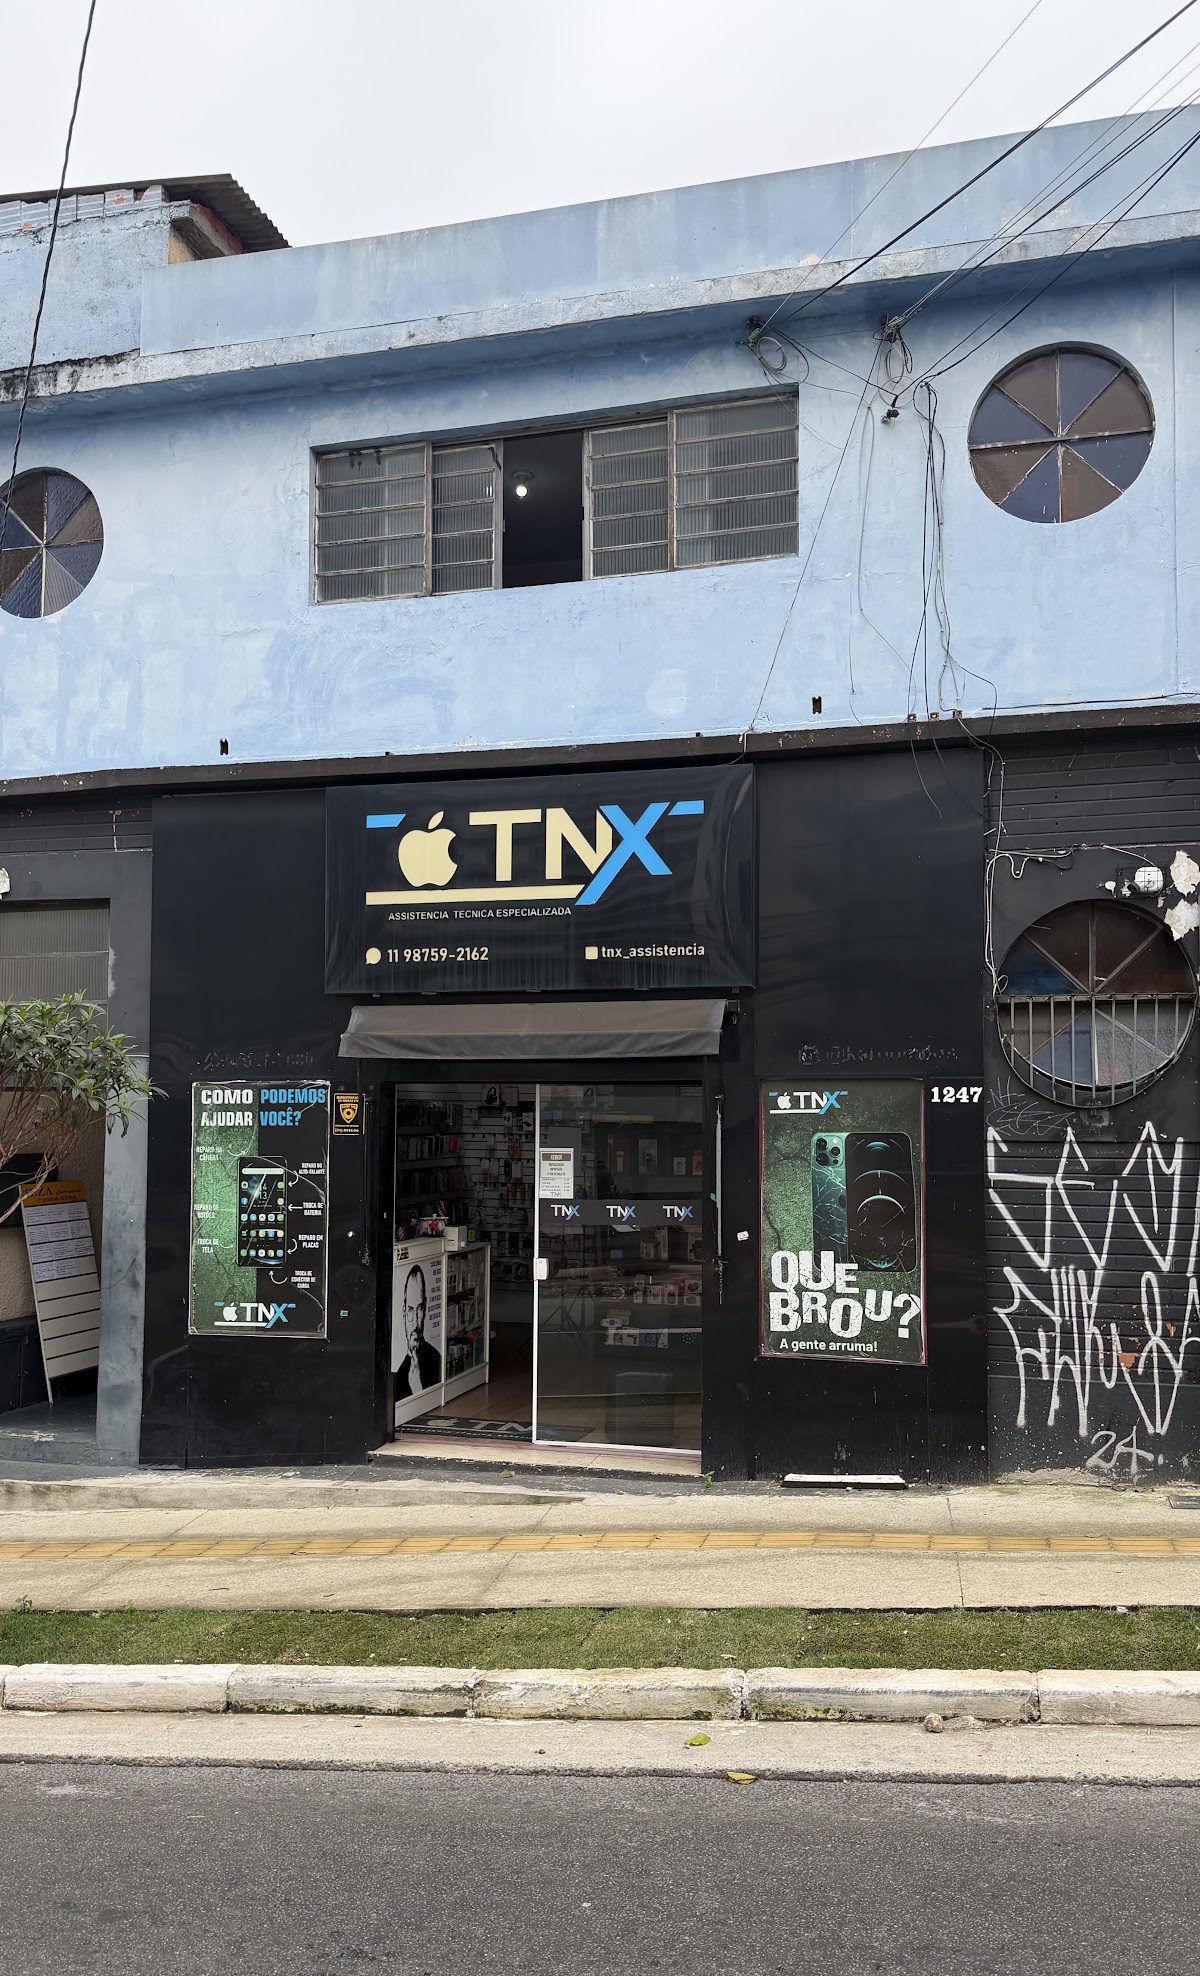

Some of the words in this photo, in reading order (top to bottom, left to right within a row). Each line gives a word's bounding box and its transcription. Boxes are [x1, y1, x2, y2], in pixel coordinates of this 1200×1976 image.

[469, 802, 673, 906] TNX
[388, 911, 449, 921] ASSISTENCIA
[453, 909, 494, 919] TECNICA
[496, 906, 572, 918] ESPECIALIZADA
[387, 949, 399, 963] 11
[403, 947, 489, 962] 98759-2162
[601, 943, 705, 959] tnx_assistencia
[201, 1089, 254, 1105] COMO
[260, 1088, 326, 1104] PODEMOS
[793, 1091, 842, 1115] TNX
[931, 1086, 983, 1103] 1247
[200, 1111, 253, 1127] AJUDAR
[259, 1107, 302, 1127] VOCÊ?
[550, 1204, 581, 1221] TNX
[605, 1205, 637, 1222] TNX
[662, 1205, 694, 1222] TNX
[302, 1241, 320, 1249] PLACAS
[770, 1250, 860, 1294] QUE
[240, 1302, 289, 1329] TNX
[769, 1289, 921, 1339] BROU?
[779, 1339, 789, 1349] A
[791, 1341, 827, 1352] gente
[828, 1341, 878, 1352] arruma!
